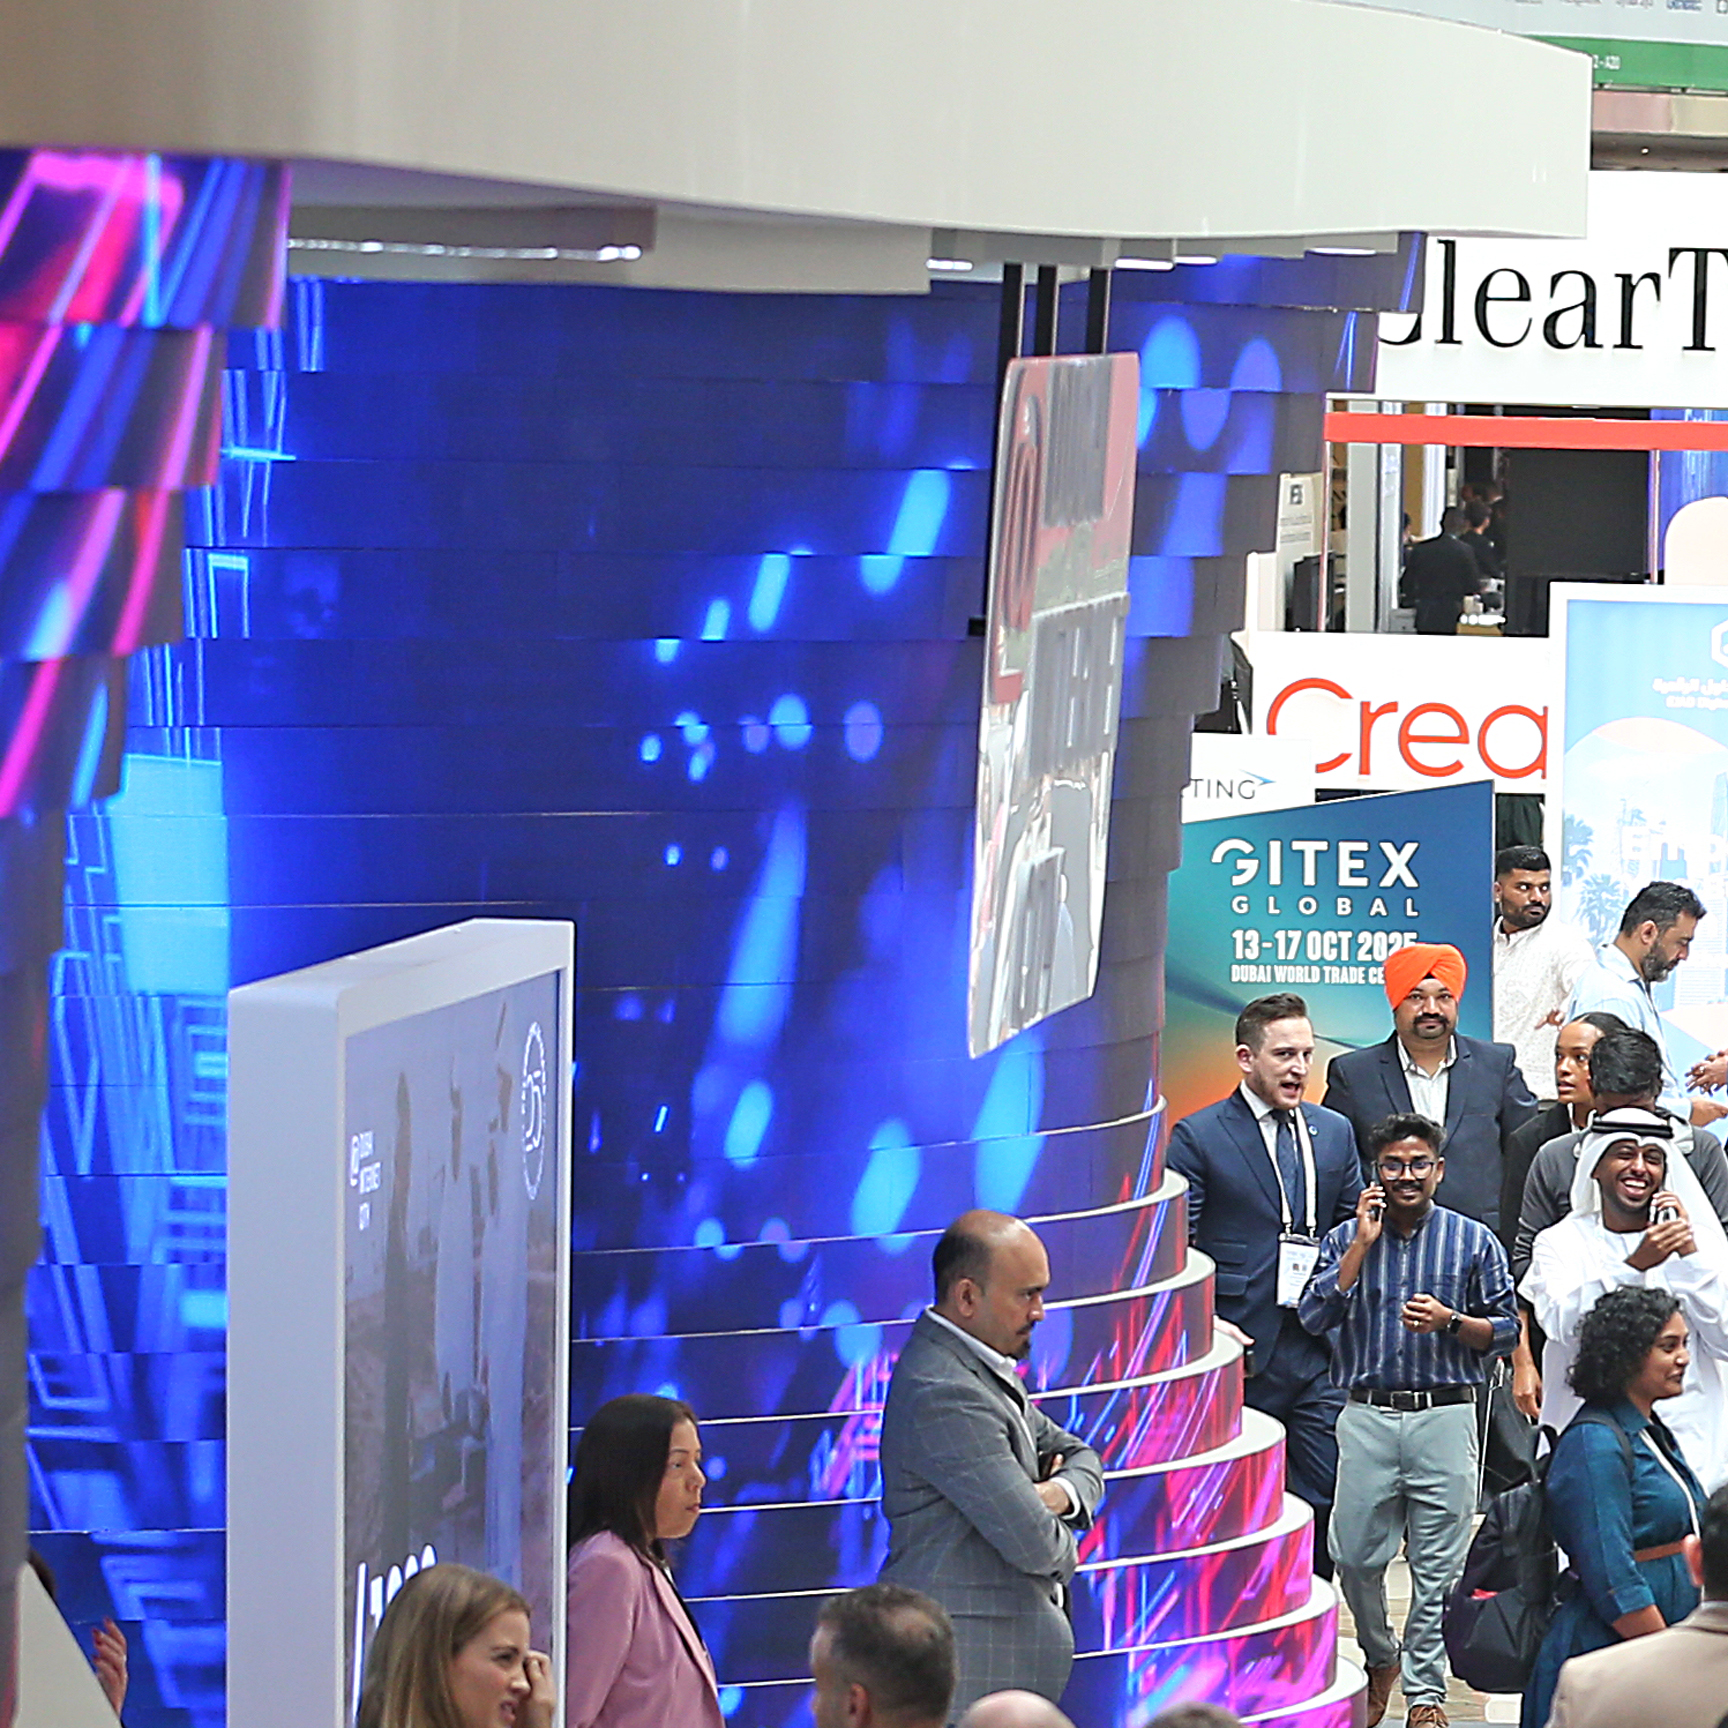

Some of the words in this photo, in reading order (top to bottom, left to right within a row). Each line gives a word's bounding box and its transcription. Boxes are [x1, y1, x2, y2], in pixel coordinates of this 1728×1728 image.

[1266, 677, 1549, 779] Crea
[1211, 838, 1420, 888] GITEX
[1231, 895, 1419, 917] GLOBAL
[1231, 929, 1302, 960] 13-17
[1306, 930, 1352, 961] OCT
[1231, 964, 1272, 983] DUBAI
[1273, 965, 1320, 984] WORLD
[1322, 966, 1366, 985] TRADE
